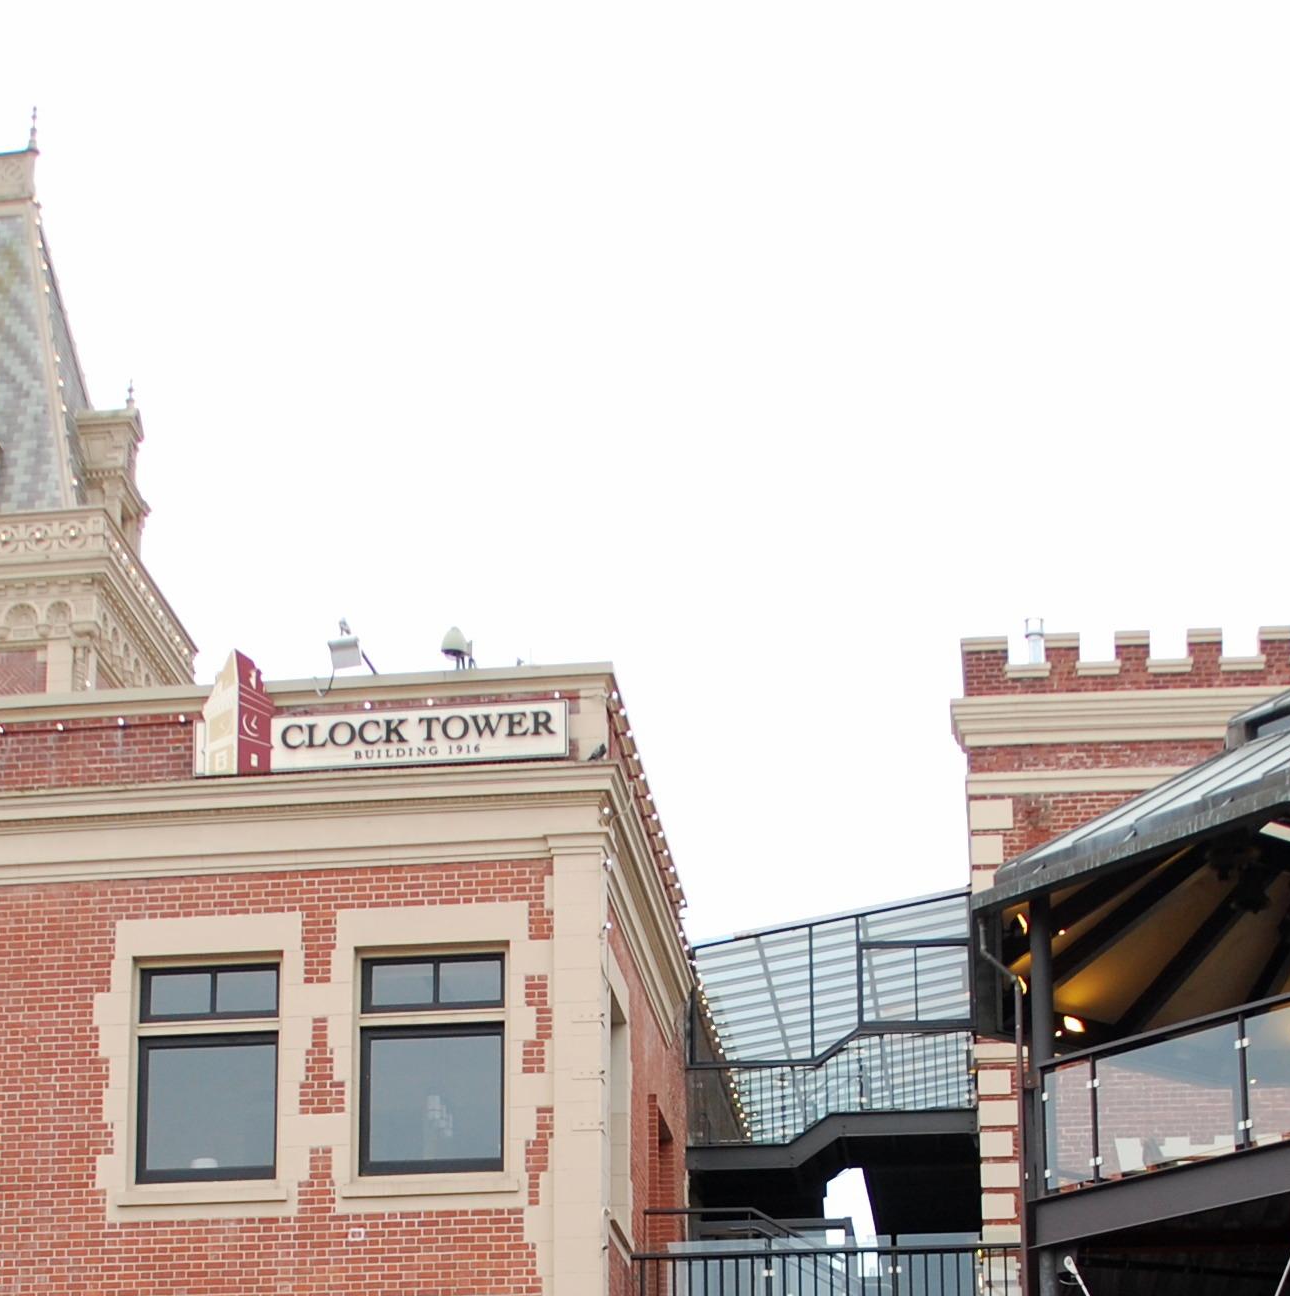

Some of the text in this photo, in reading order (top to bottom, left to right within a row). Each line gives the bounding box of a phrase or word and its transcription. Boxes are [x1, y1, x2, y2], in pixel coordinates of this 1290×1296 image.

[280, 710, 557, 750] CLOCK TOWER
[354, 743, 481, 760] BUILDING 1916
